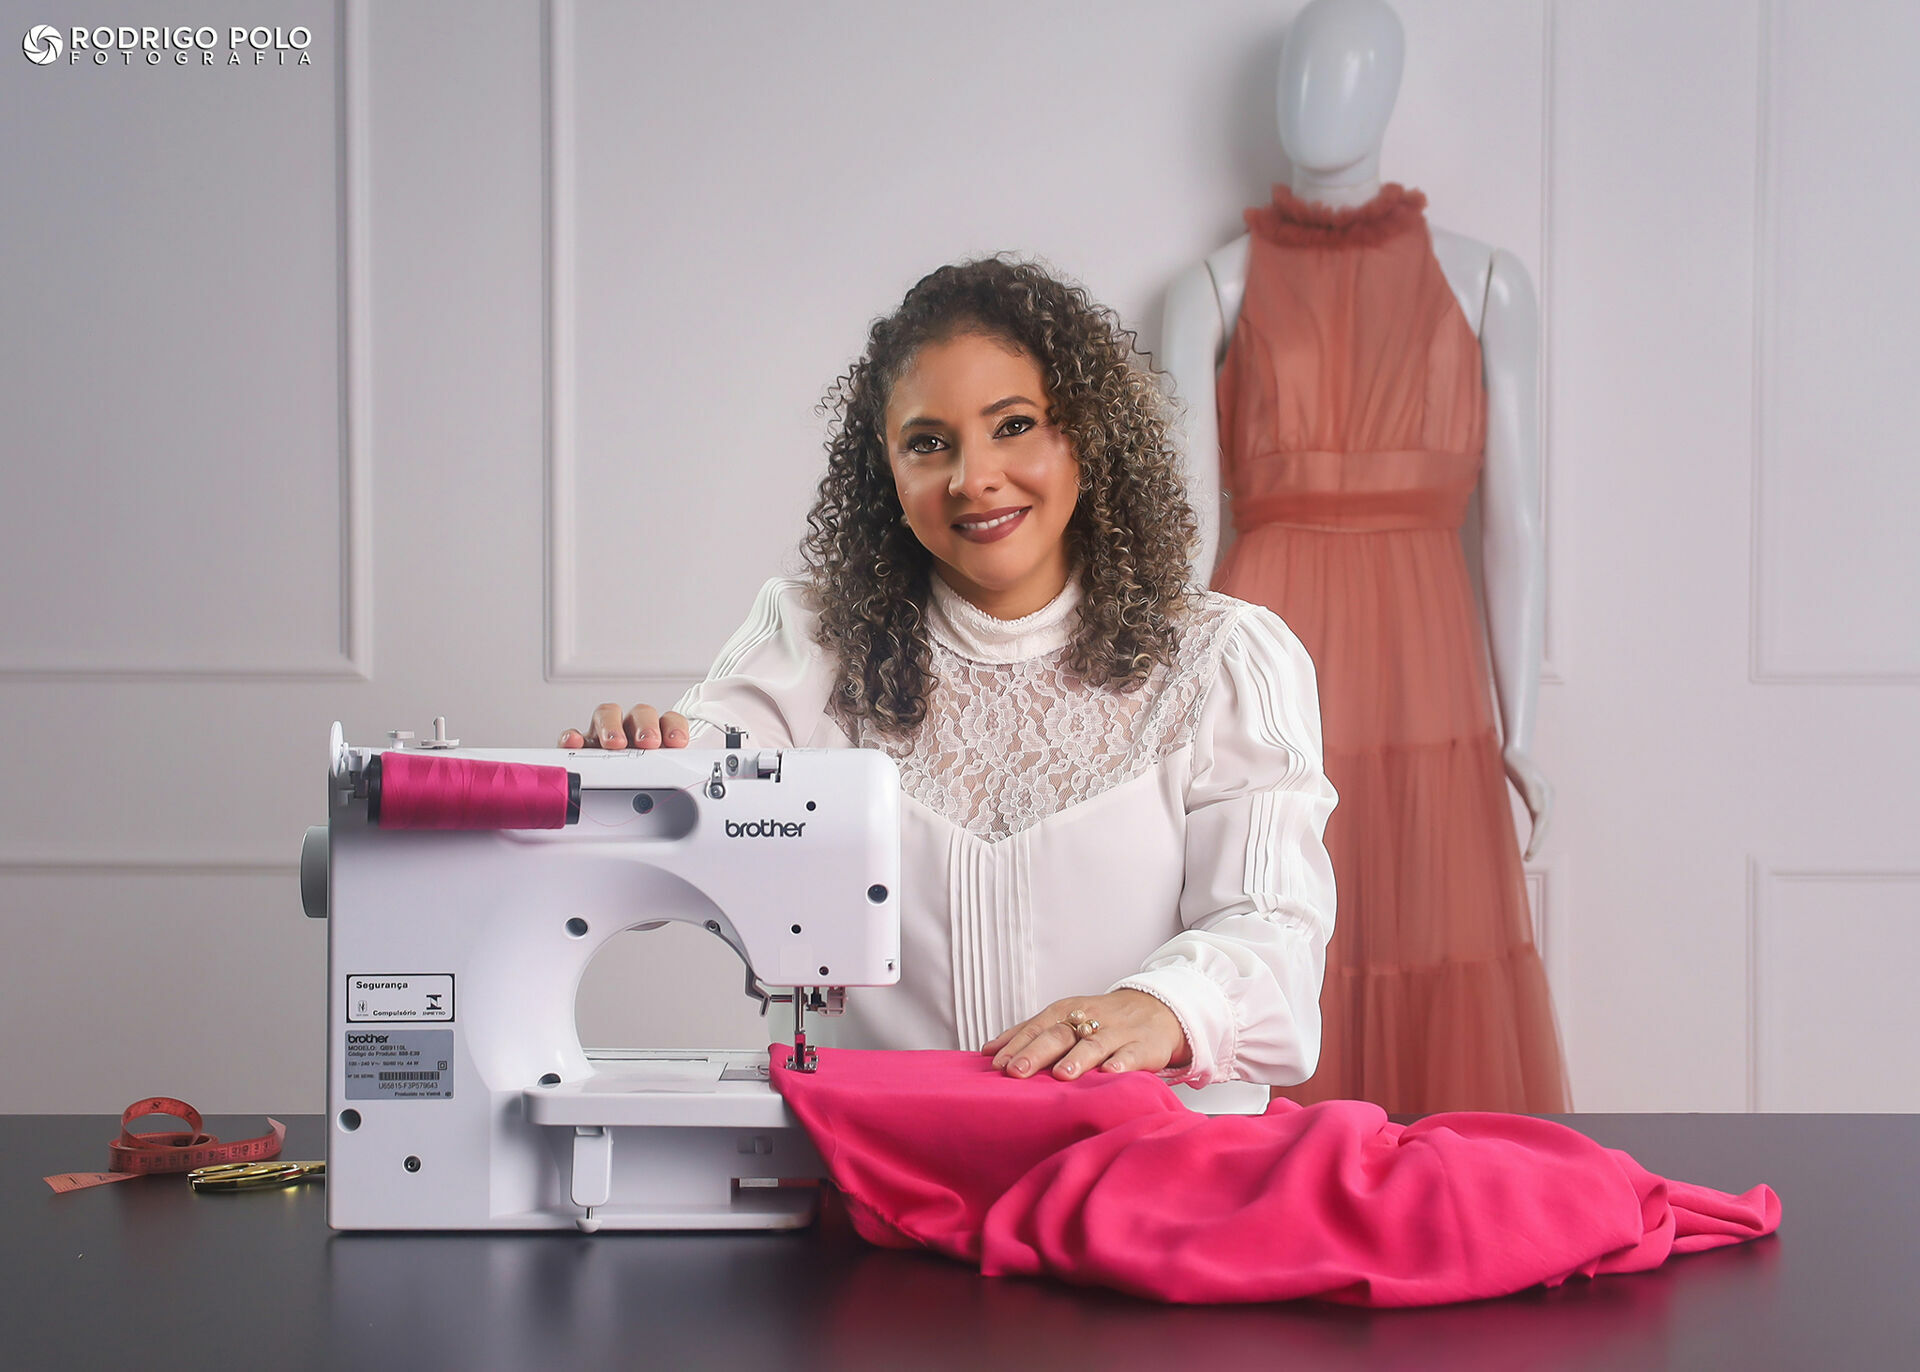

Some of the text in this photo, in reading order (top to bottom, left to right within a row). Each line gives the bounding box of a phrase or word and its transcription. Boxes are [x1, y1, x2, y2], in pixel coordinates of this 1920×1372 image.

[725, 819, 806, 838] brother
[356, 980, 408, 990] Segurança
[347, 1033, 389, 1043] brother
